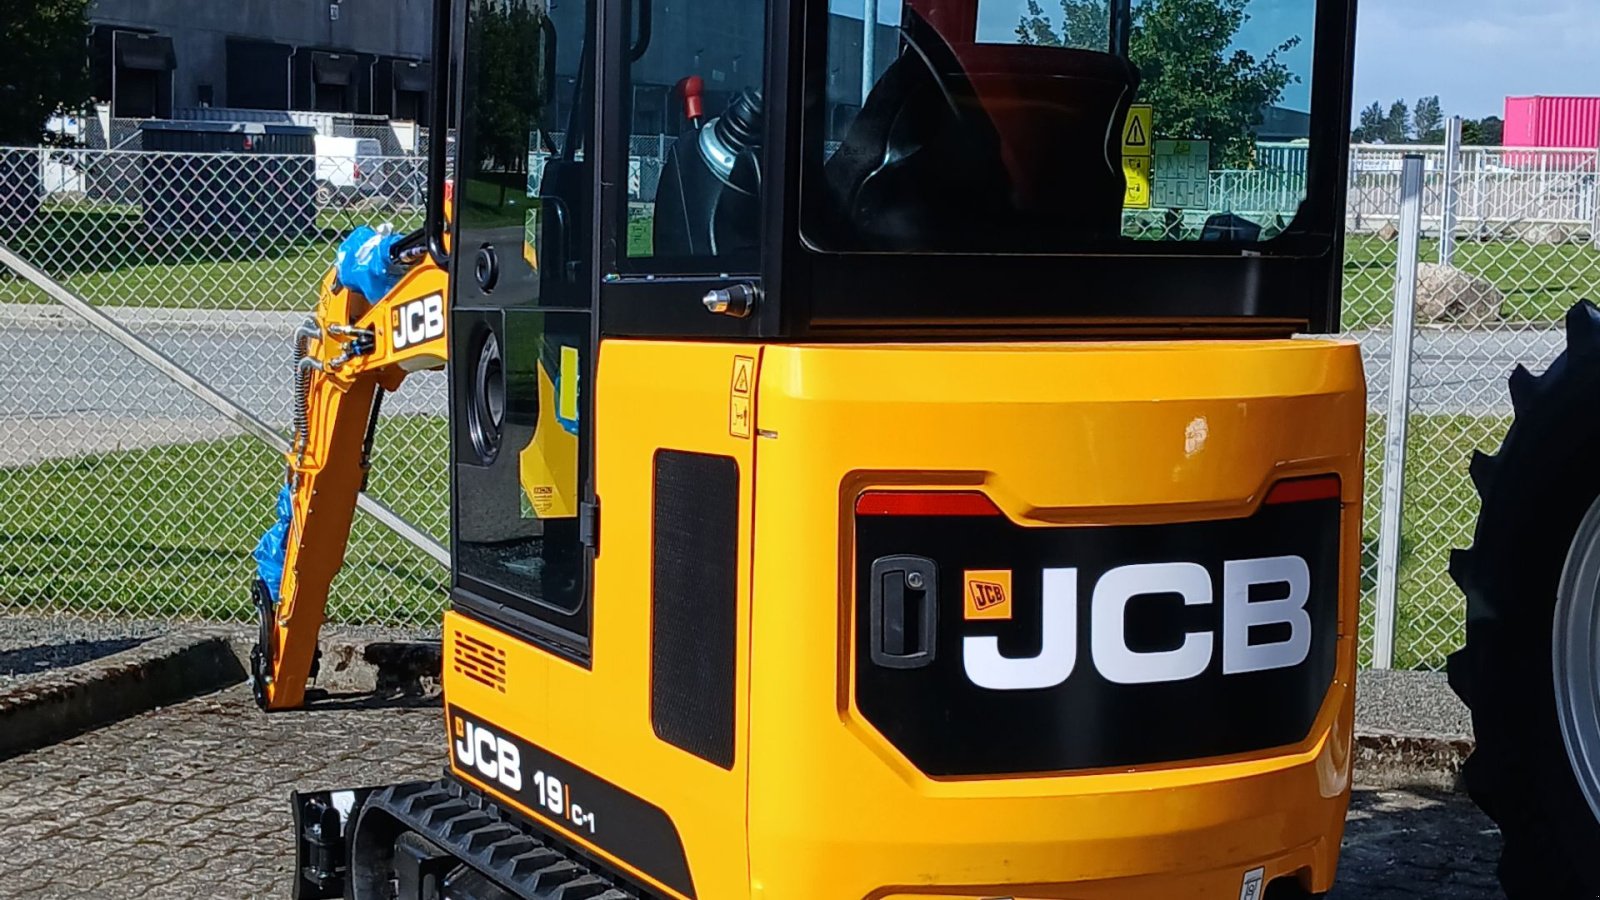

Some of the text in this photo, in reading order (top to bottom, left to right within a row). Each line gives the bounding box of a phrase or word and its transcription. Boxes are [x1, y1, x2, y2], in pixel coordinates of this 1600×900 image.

[393, 294, 444, 348] JCB
[963, 555, 1311, 690] JCB
[975, 583, 1003, 607] JCB
[456, 721, 522, 791] JCB
